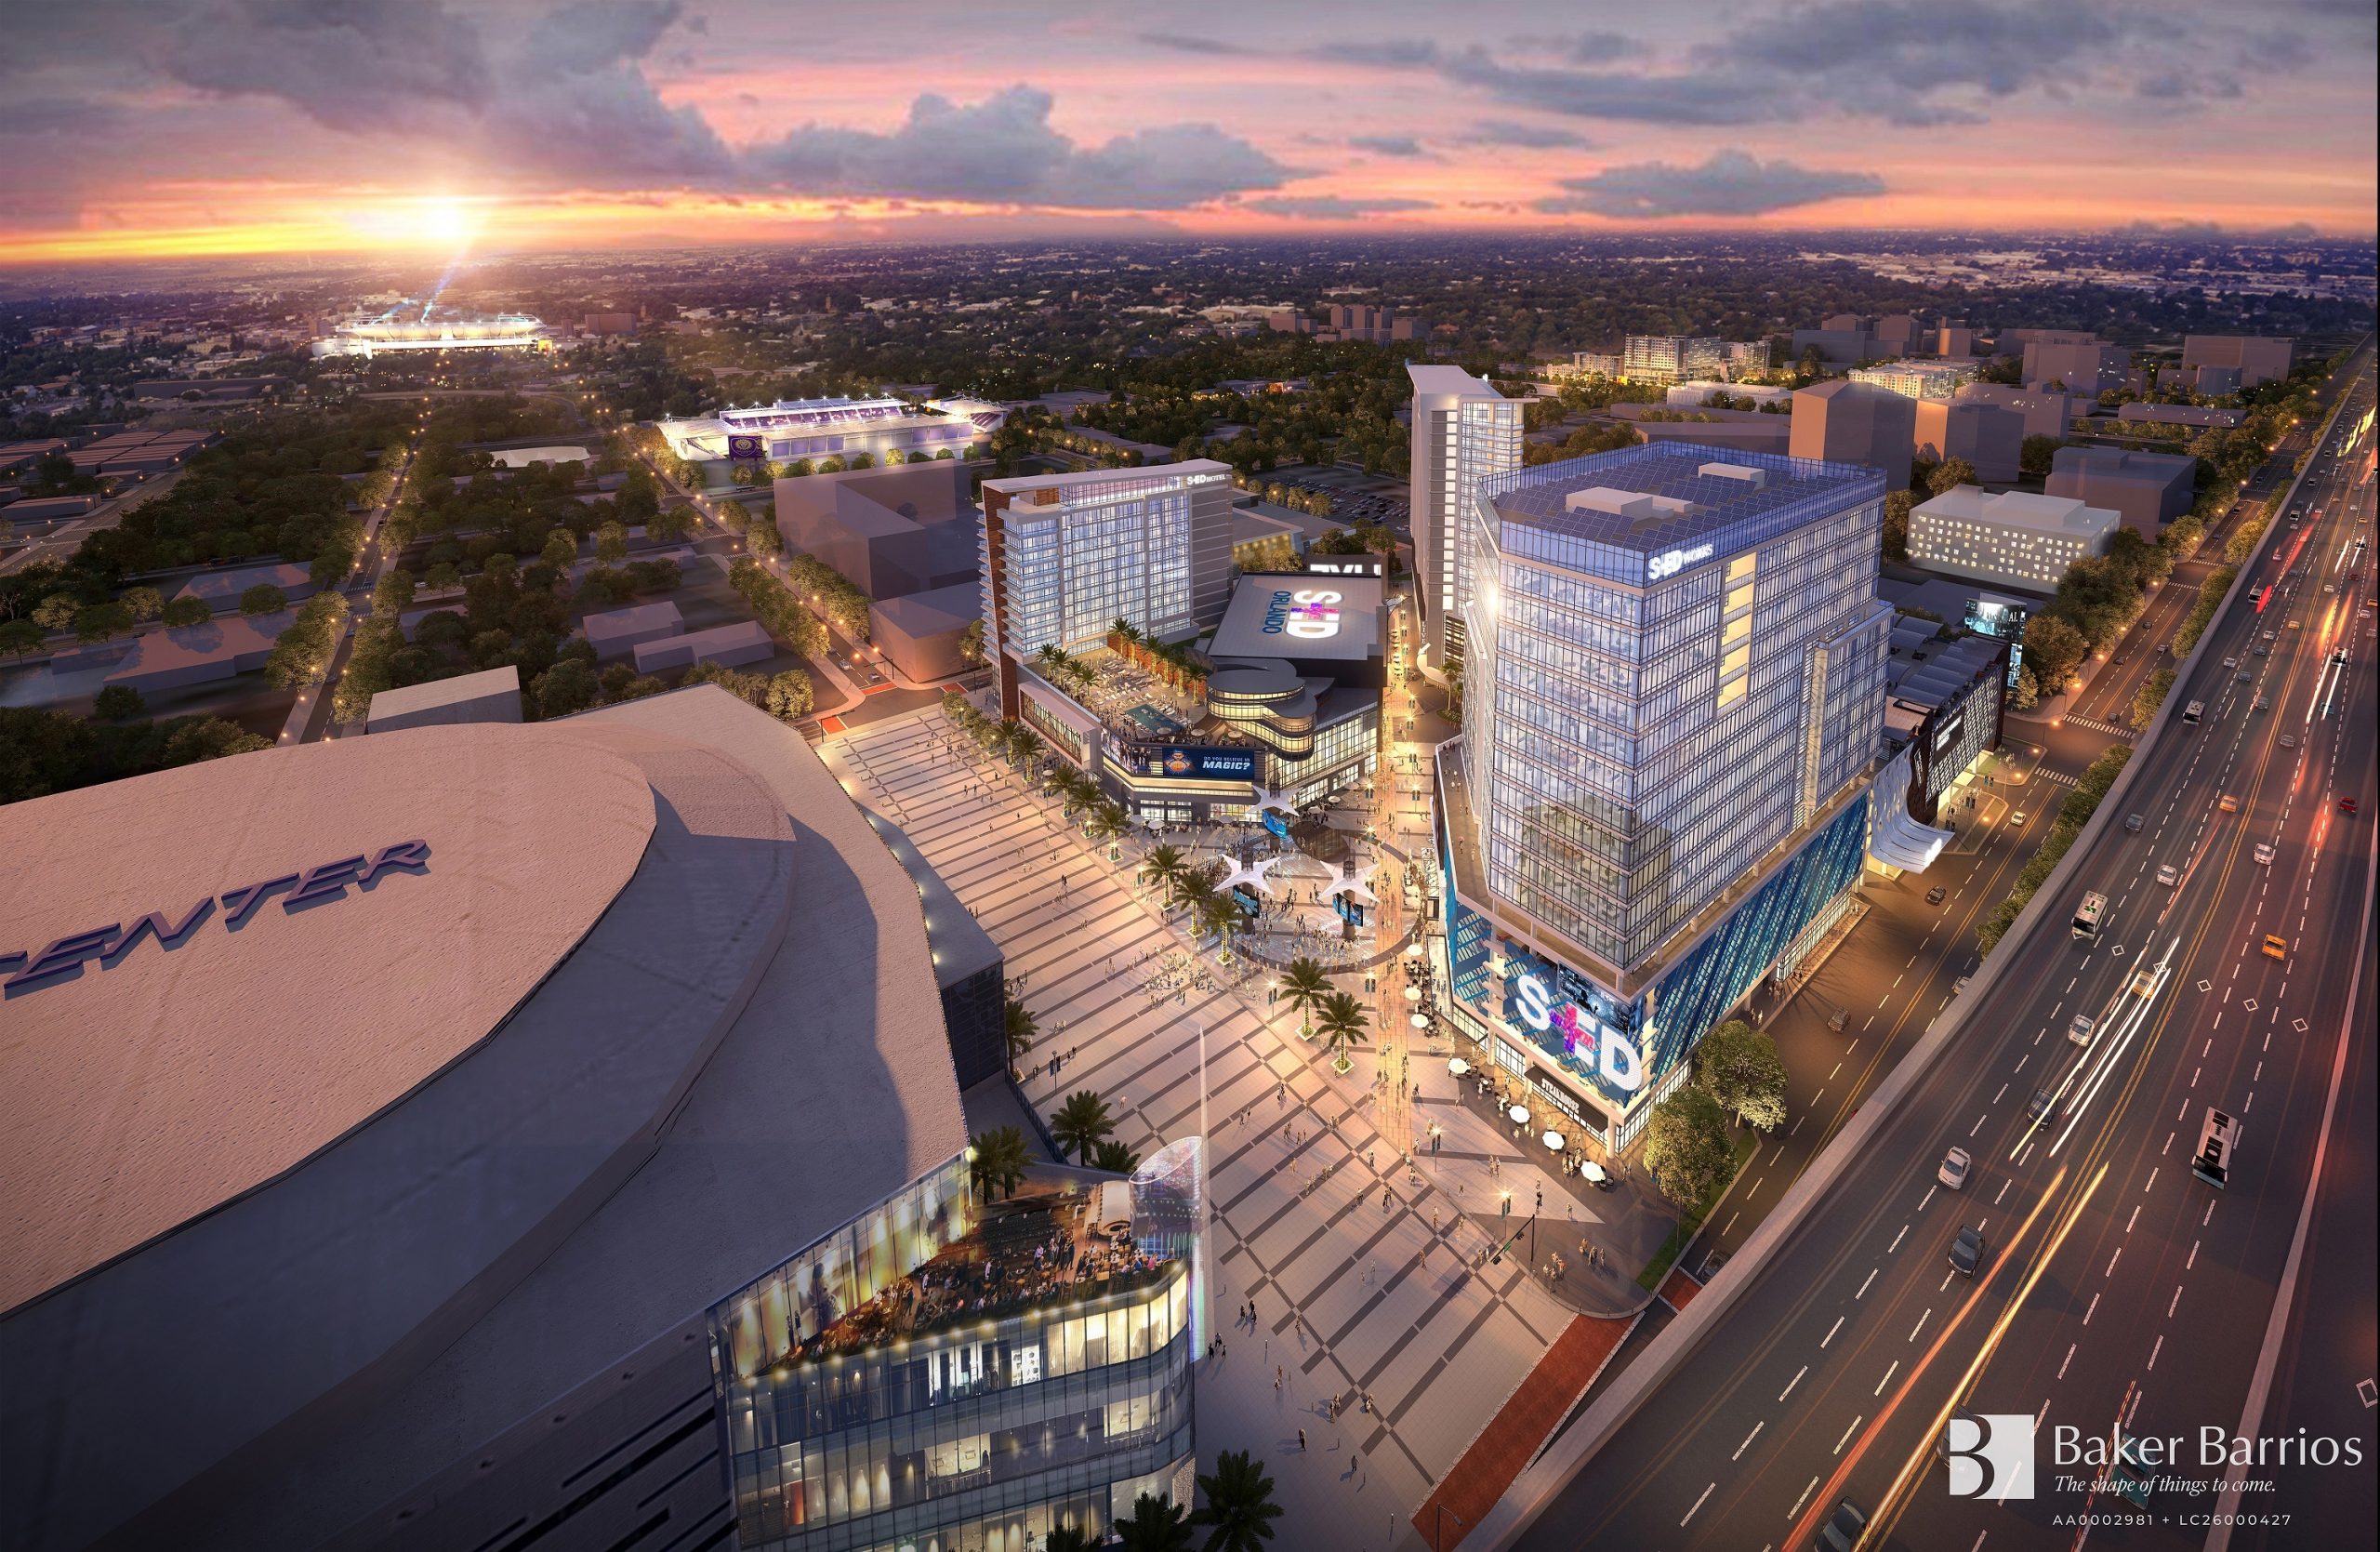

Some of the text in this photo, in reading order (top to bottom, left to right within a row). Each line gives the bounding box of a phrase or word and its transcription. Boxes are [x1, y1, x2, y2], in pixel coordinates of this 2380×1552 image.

[1683, 543, 1713, 564] WORKS
[1262, 590, 1292, 634] ORLANDO
[1202, 761, 1250, 770] MAGIC?
[0, 838, 430, 993] ENTER
